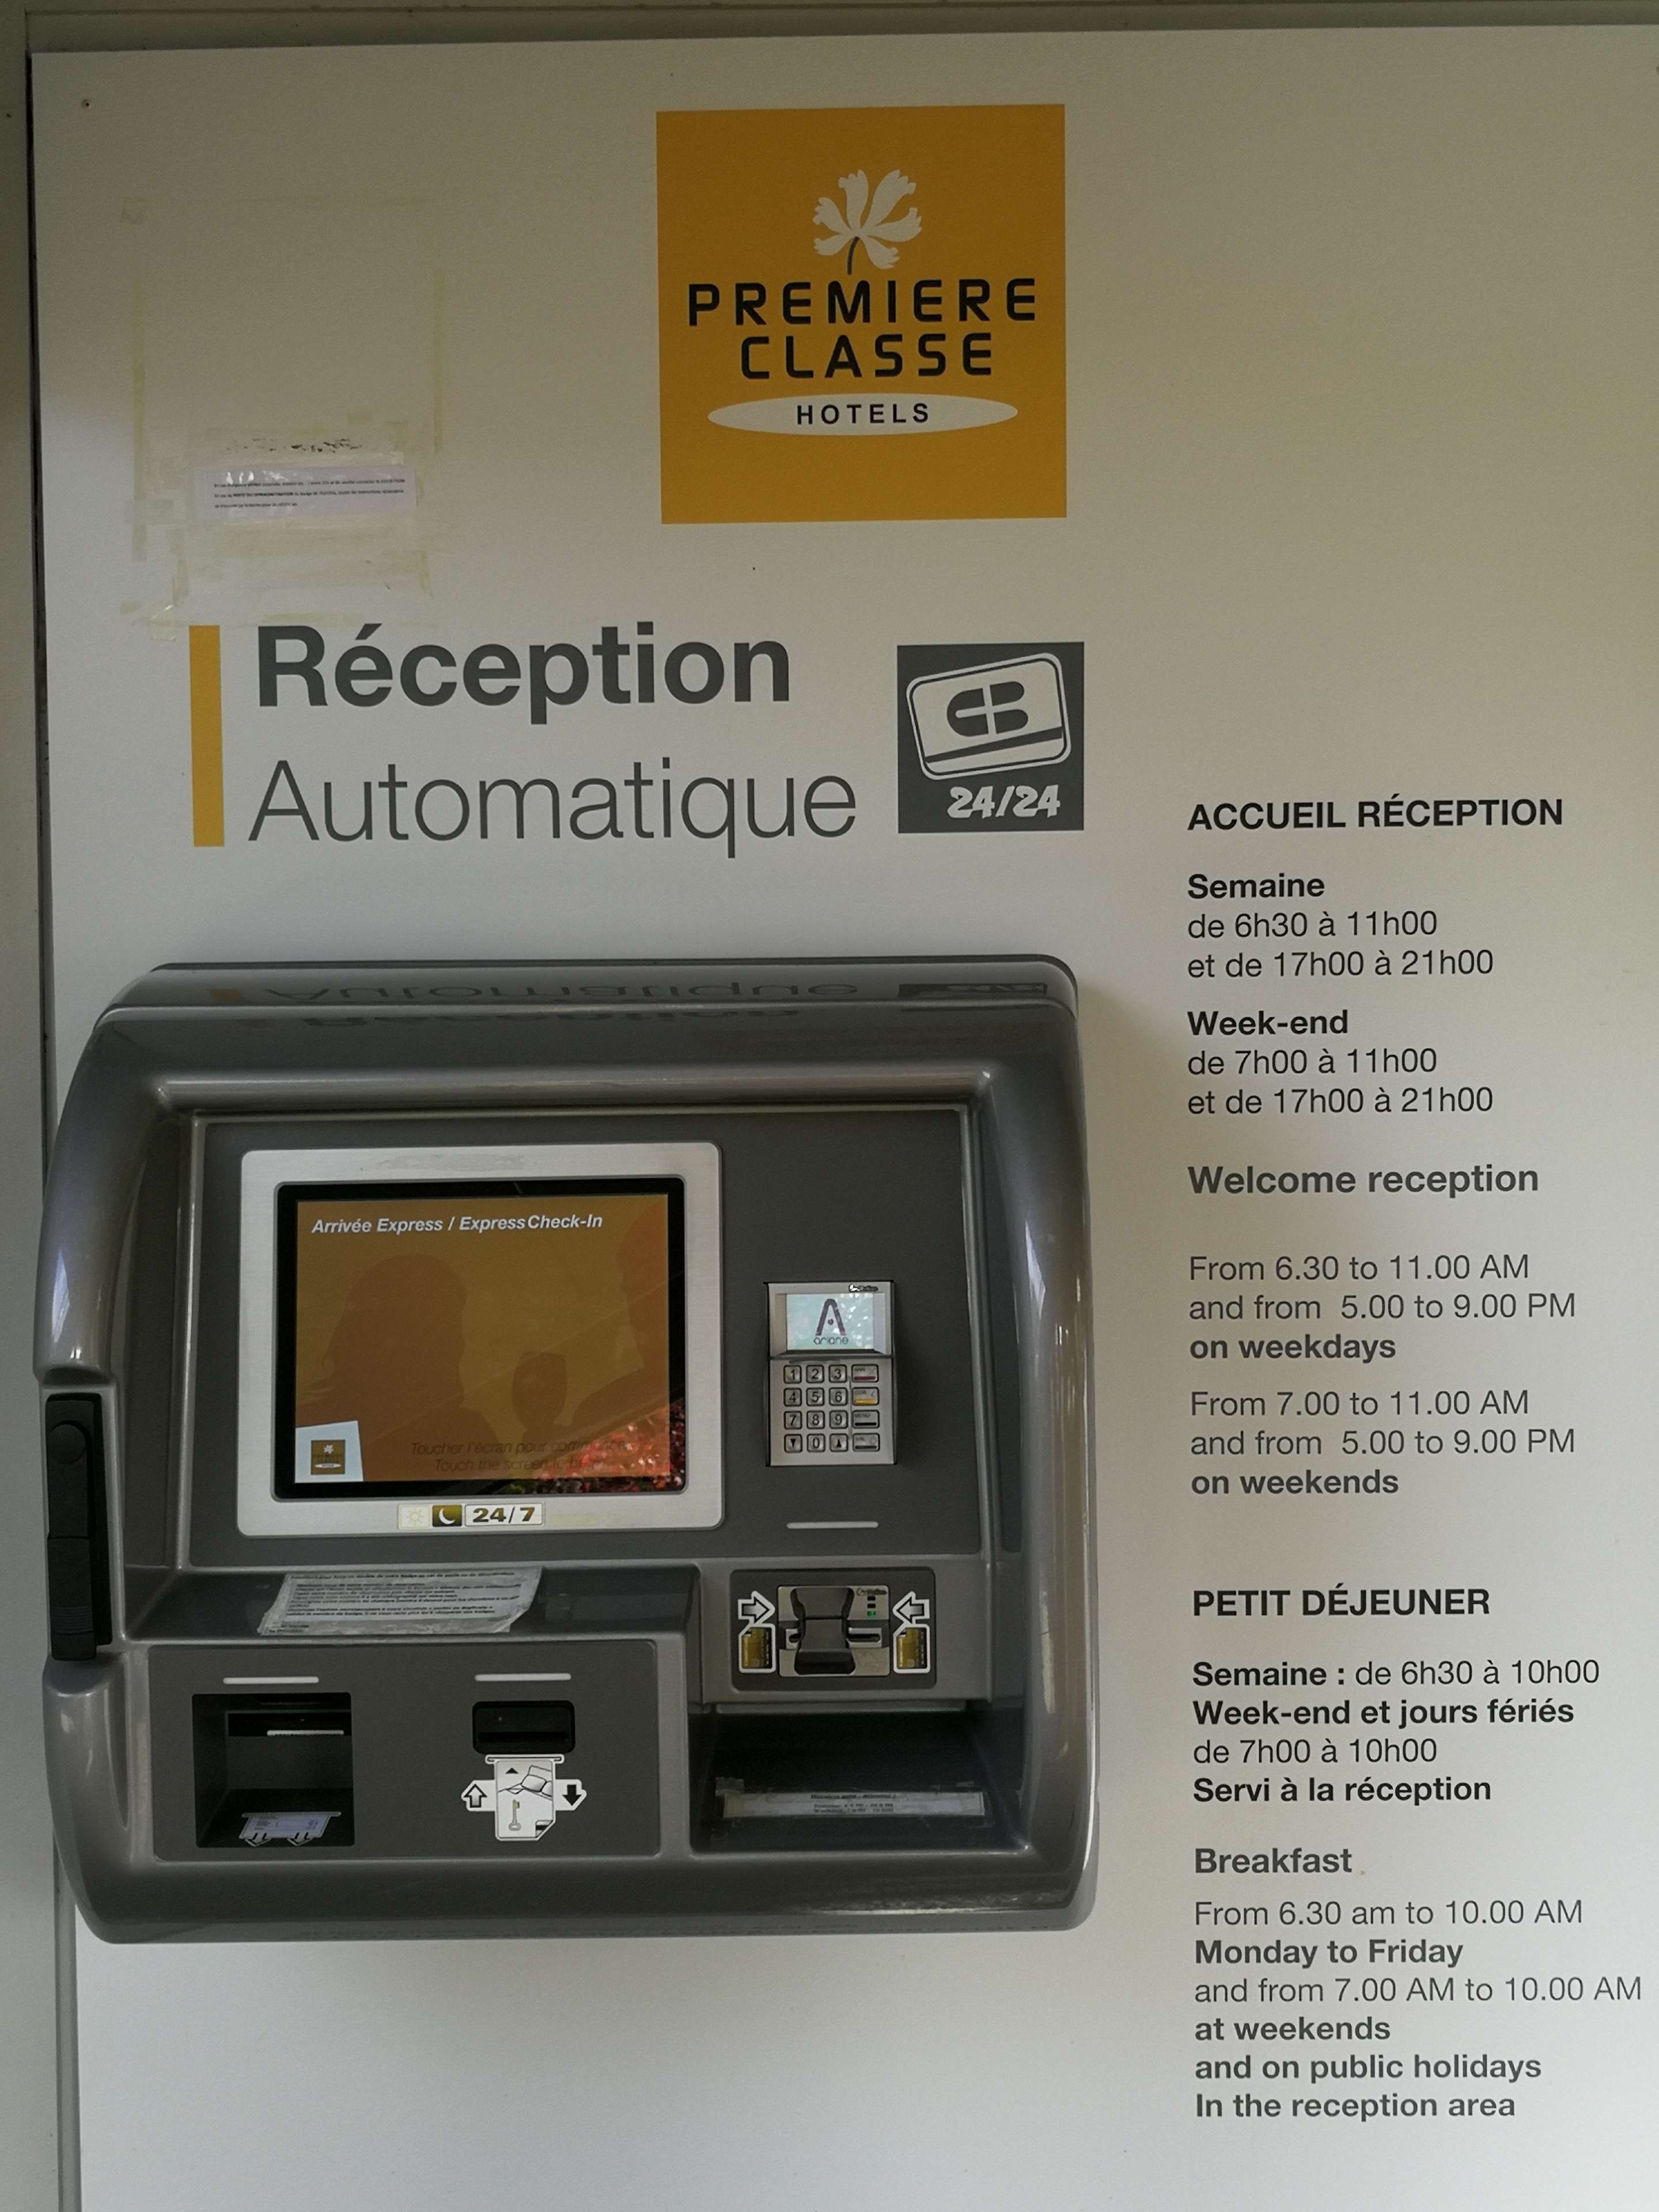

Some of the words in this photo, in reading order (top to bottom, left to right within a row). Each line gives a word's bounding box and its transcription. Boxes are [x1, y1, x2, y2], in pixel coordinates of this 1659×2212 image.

[689, 278, 1035, 326] PREMIERE
[741, 333, 991, 379] CLASSE
[797, 403, 927, 425] HOTELS
[258, 622, 789, 725] Réception
[946, 681, 1029, 737] CB
[248, 757, 855, 858] Automatique
[948, 785, 1060, 819] 24/24
[1188, 802, 1346, 830] ACCUEIL
[1359, 794, 1562, 827] RÉCEPTION
[1188, 873, 1324, 899] Semaine
[1188, 914, 1224, 938] de
[1236, 912, 1307, 937] 6h30
[1319, 911, 1335, 936] à
[1348, 911, 1437, 935] 11h00
[1188, 955, 1215, 978] et
[1226, 953, 1262, 977] de
[1275, 952, 1363, 976] 17h00
[1375, 950, 1391, 975] à
[1402, 949, 1493, 975] 21h00
[1187, 1010, 1347, 1035] Week-end
[1188, 1051, 1224, 1075] de
[1236, 1050, 1306, 1074] 7h00
[1319, 1048, 1335, 1073] à
[1347, 1048, 1436, 1073] 11h00
[1188, 1091, 1215, 1114] et
[1226, 1089, 1262, 1113] de
[1274, 1089, 1363, 1113] 17h00
[1375, 1088, 1391, 1112] à
[1402, 1087, 1493, 1112] 21h00
[1188, 1166, 1355, 1194] Welcome
[1369, 1164, 1537, 1198] reception
[312, 1218, 372, 1233] Arrivée
[376, 1218, 443, 1234] Express
[447, 1216, 455, 1231] /
[1191, 1256, 1264, 1280] From
[1276, 1256, 1338, 1280] 6.30
[1349, 1257, 1377, 1279] to
[1391, 1255, 1469, 1279] 11.00
[1480, 1255, 1528, 1278] AM
[1190, 1296, 1243, 1319] and
[1254, 1295, 1320, 1319] from
[1342, 1295, 1403, 1319] 5.00
[1414, 1296, 1442, 1318] to
[1455, 1294, 1516, 1318] 9.00
[1529, 1293, 1574, 1317] PM
[813, 1336, 849, 1346] ariane
[1190, 1340, 1228, 1358] on
[1238, 1334, 1395, 1363] weekdays
[790, 1369, 796, 1380] 1
[812, 1368, 820, 1380] 2
[834, 1368, 842, 1380] 3
[789, 1392, 797, 1403] 4
[812, 1392, 819, 1403] 5
[835, 1391, 842, 1402] 6
[1192, 1392, 1265, 1415] From
[1277, 1392, 1339, 1415] 7.00
[1350, 1392, 1378, 1415] to
[1391, 1391, 1469, 1415] 11.00
[1480, 1390, 1527, 1414] AM
[789, 1414, 797, 1426] 7
[812, 1414, 820, 1425] 8
[835, 1414, 843, 1425] 9
[411, 1442, 463, 1455] Toucher
[515, 1442, 547, 1456] pour
[812, 1437, 820, 1449] 0
[1191, 1431, 1244, 1455] and
[1255, 1430, 1321, 1455] from
[1342, 1430, 1404, 1454] 5.00
[1415, 1431, 1442, 1453] to
[1455, 1430, 1516, 1453] 9.00
[1529, 1429, 1574, 1453] PM
[435, 1459, 475, 1472] Touch
[478, 1458, 499, 1471] the
[1192, 1476, 1229, 1494] on
[1240, 1469, 1398, 1494] weekends
[472, 1506, 536, 1524] 24/7
[1194, 1590, 1290, 1616] PETIT
[1302, 1583, 1489, 1615] DÉJEUNER
[1193, 1662, 1327, 1686] Semaine
[1339, 1668, 1344, 1685] :
[1356, 1661, 1391, 1685] de
[1402, 1661, 1472, 1684] 6h30
[1484, 1660, 1499, 1684] à
[1512, 1660, 1599, 1683] 10h00
[1193, 1700, 1349, 1725] Week-end
[1361, 1701, 1390, 1724] et
[1399, 1700, 1477, 1729] jours
[1487, 1698, 1573, 1722] fériés
[1194, 1740, 1229, 1763] de
[1240, 1739, 1310, 1763] 7h00
[1321, 1738, 1338, 1763] à
[1350, 1738, 1436, 1762] 10h00
[1194, 1778, 1269, 1802] Servi
[1281, 1777, 1297, 1801] à
[1310, 1778, 1334, 1801] la
[1346, 1777, 1490, 1806] réception
[1196, 1848, 1352, 1873] Breakfast
[1196, 1902, 1267, 1925] From
[1280, 1902, 1340, 1925] 6.30
[1353, 1907, 1394, 1925] am
[1406, 1902, 1433, 1924] to
[1446, 1900, 1523, 1923] 10.00
[1535, 1900, 1581, 1923] AM
[1196, 1940, 1317, 1968] Monday
[1327, 1941, 1357, 1963] to
[1370, 1939, 1463, 1968] Friday
[1195, 1979, 1247, 2002] and
[1258, 1978, 1323, 2002] from
[1335, 1978, 1395, 2001] 7.00
[1406, 1978, 1453, 2001] AM
[1465, 1979, 1493, 2001] to
[1506, 1977, 1583, 2001] 10.00
[1594, 1977, 1640, 2000] AM
[1195, 2018, 1224, 2040] at
[1234, 2017, 1390, 2040] weekends
[1196, 2055, 1251, 2078] and
[1263, 2061, 1298, 2078] on
[1311, 2055, 1403, 2084] public
[1415, 2054, 1541, 2083] holidays
[1197, 2094, 1222, 2117] In
[1233, 2093, 1281, 2117] the
[1293, 2093, 1437, 2122] reception
[1449, 2099, 1514, 2116] area
